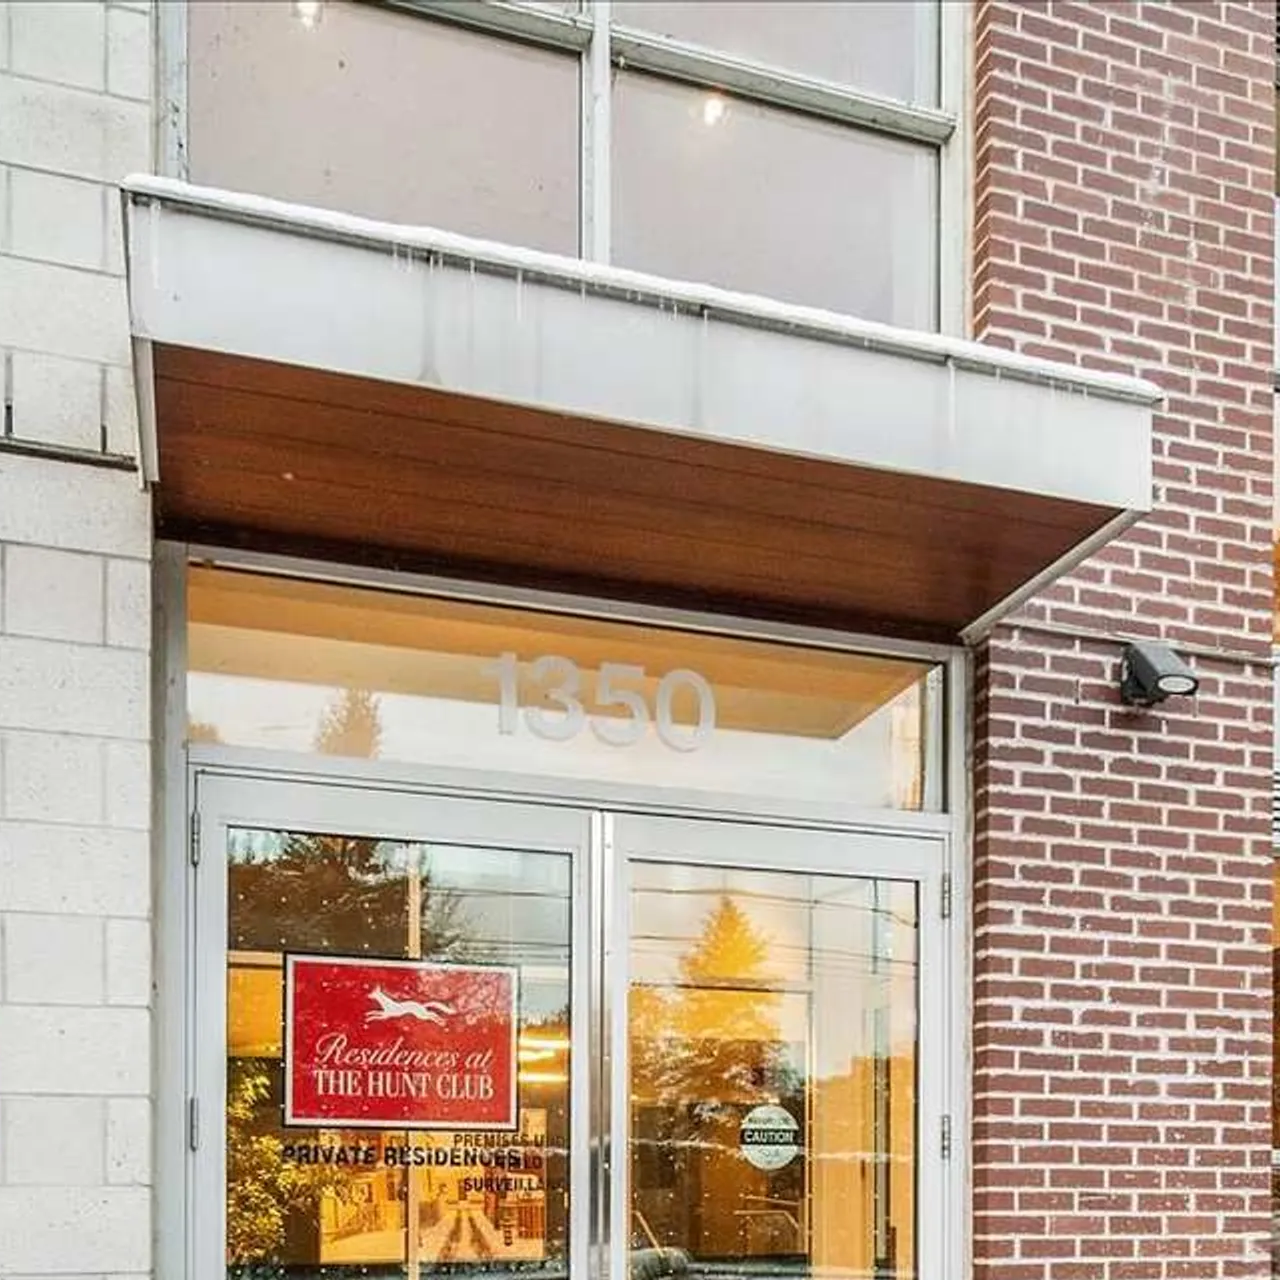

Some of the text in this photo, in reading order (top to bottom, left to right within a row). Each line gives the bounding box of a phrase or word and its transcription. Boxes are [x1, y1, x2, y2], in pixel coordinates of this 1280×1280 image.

[482, 651, 716, 752] 1350
[313, 1031, 493, 1069] Residences at
[313, 1068, 494, 1101] THE HUNT CLUB
[453, 1133, 532, 1149] PREMISES
[743, 1130, 796, 1143] CAUTION
[282, 1144, 378, 1166] PRIVATE
[383, 1146, 522, 1170] RESIDENCES
